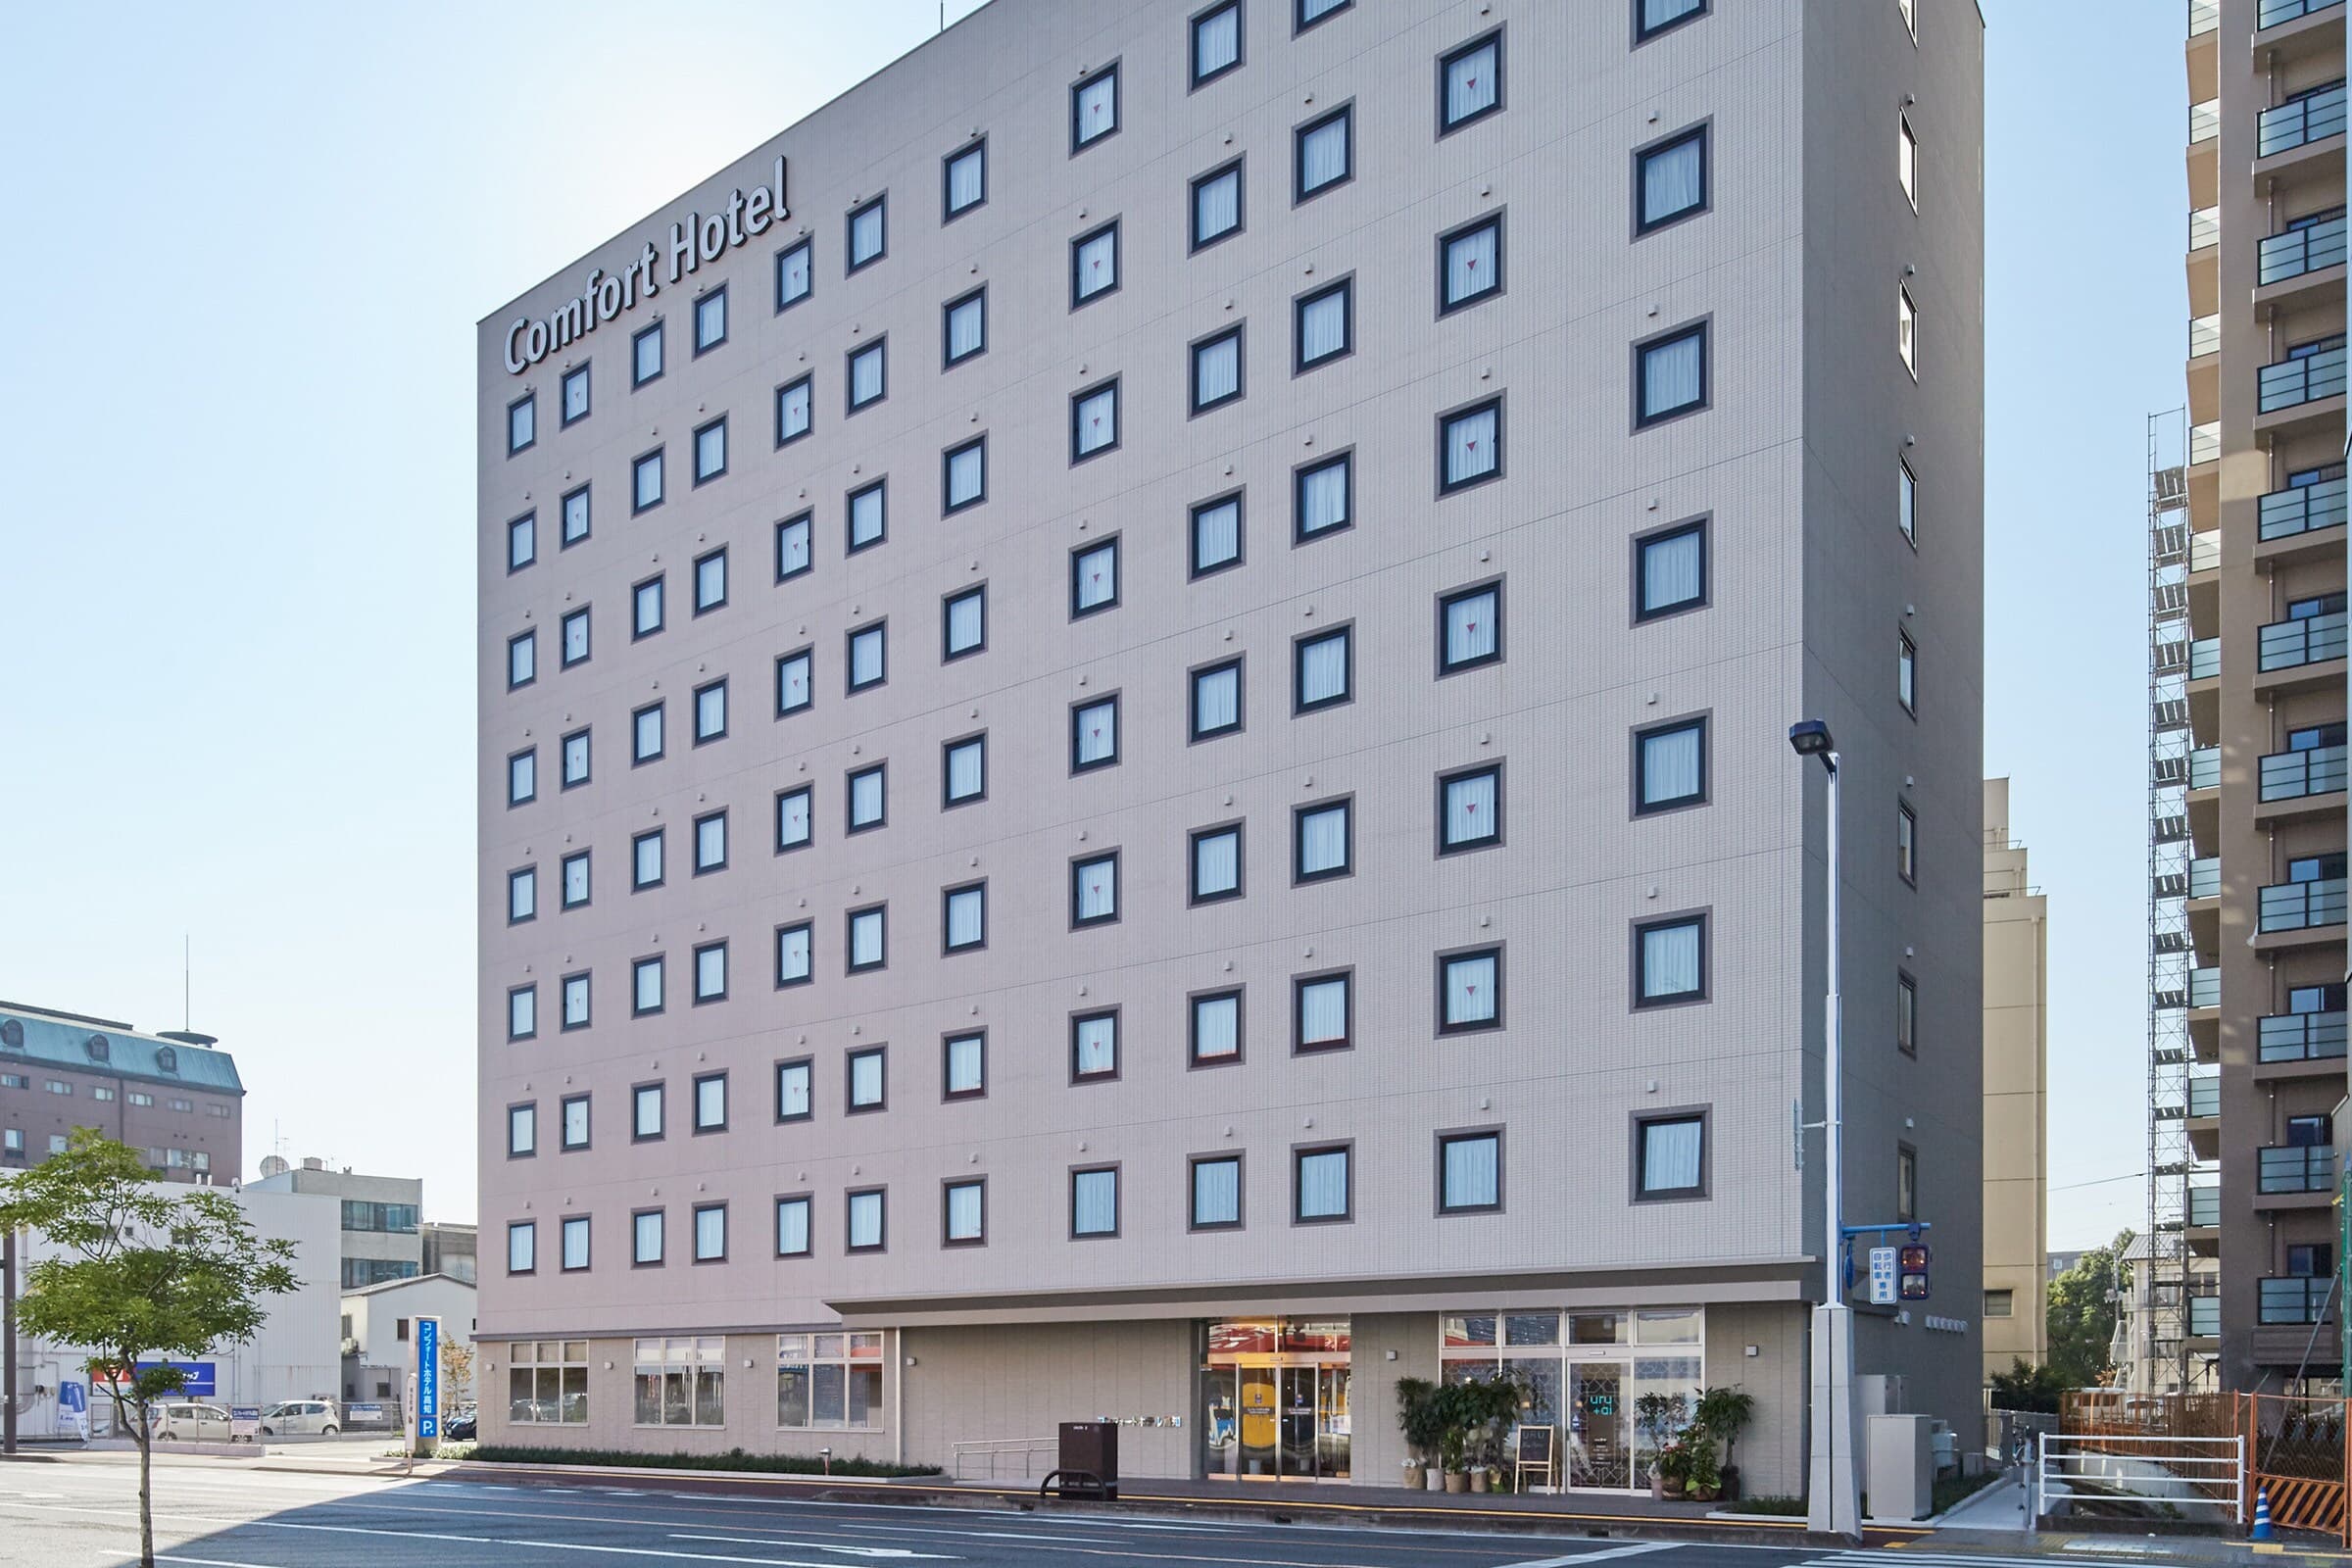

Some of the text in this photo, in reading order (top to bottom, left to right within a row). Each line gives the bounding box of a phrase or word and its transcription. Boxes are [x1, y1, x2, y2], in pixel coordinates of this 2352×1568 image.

[504, 155, 790, 374] Comfort Hotel
[423, 1322, 432, 1414] コンフォートホテル高知
[1591, 1396, 1612, 1404] uru
